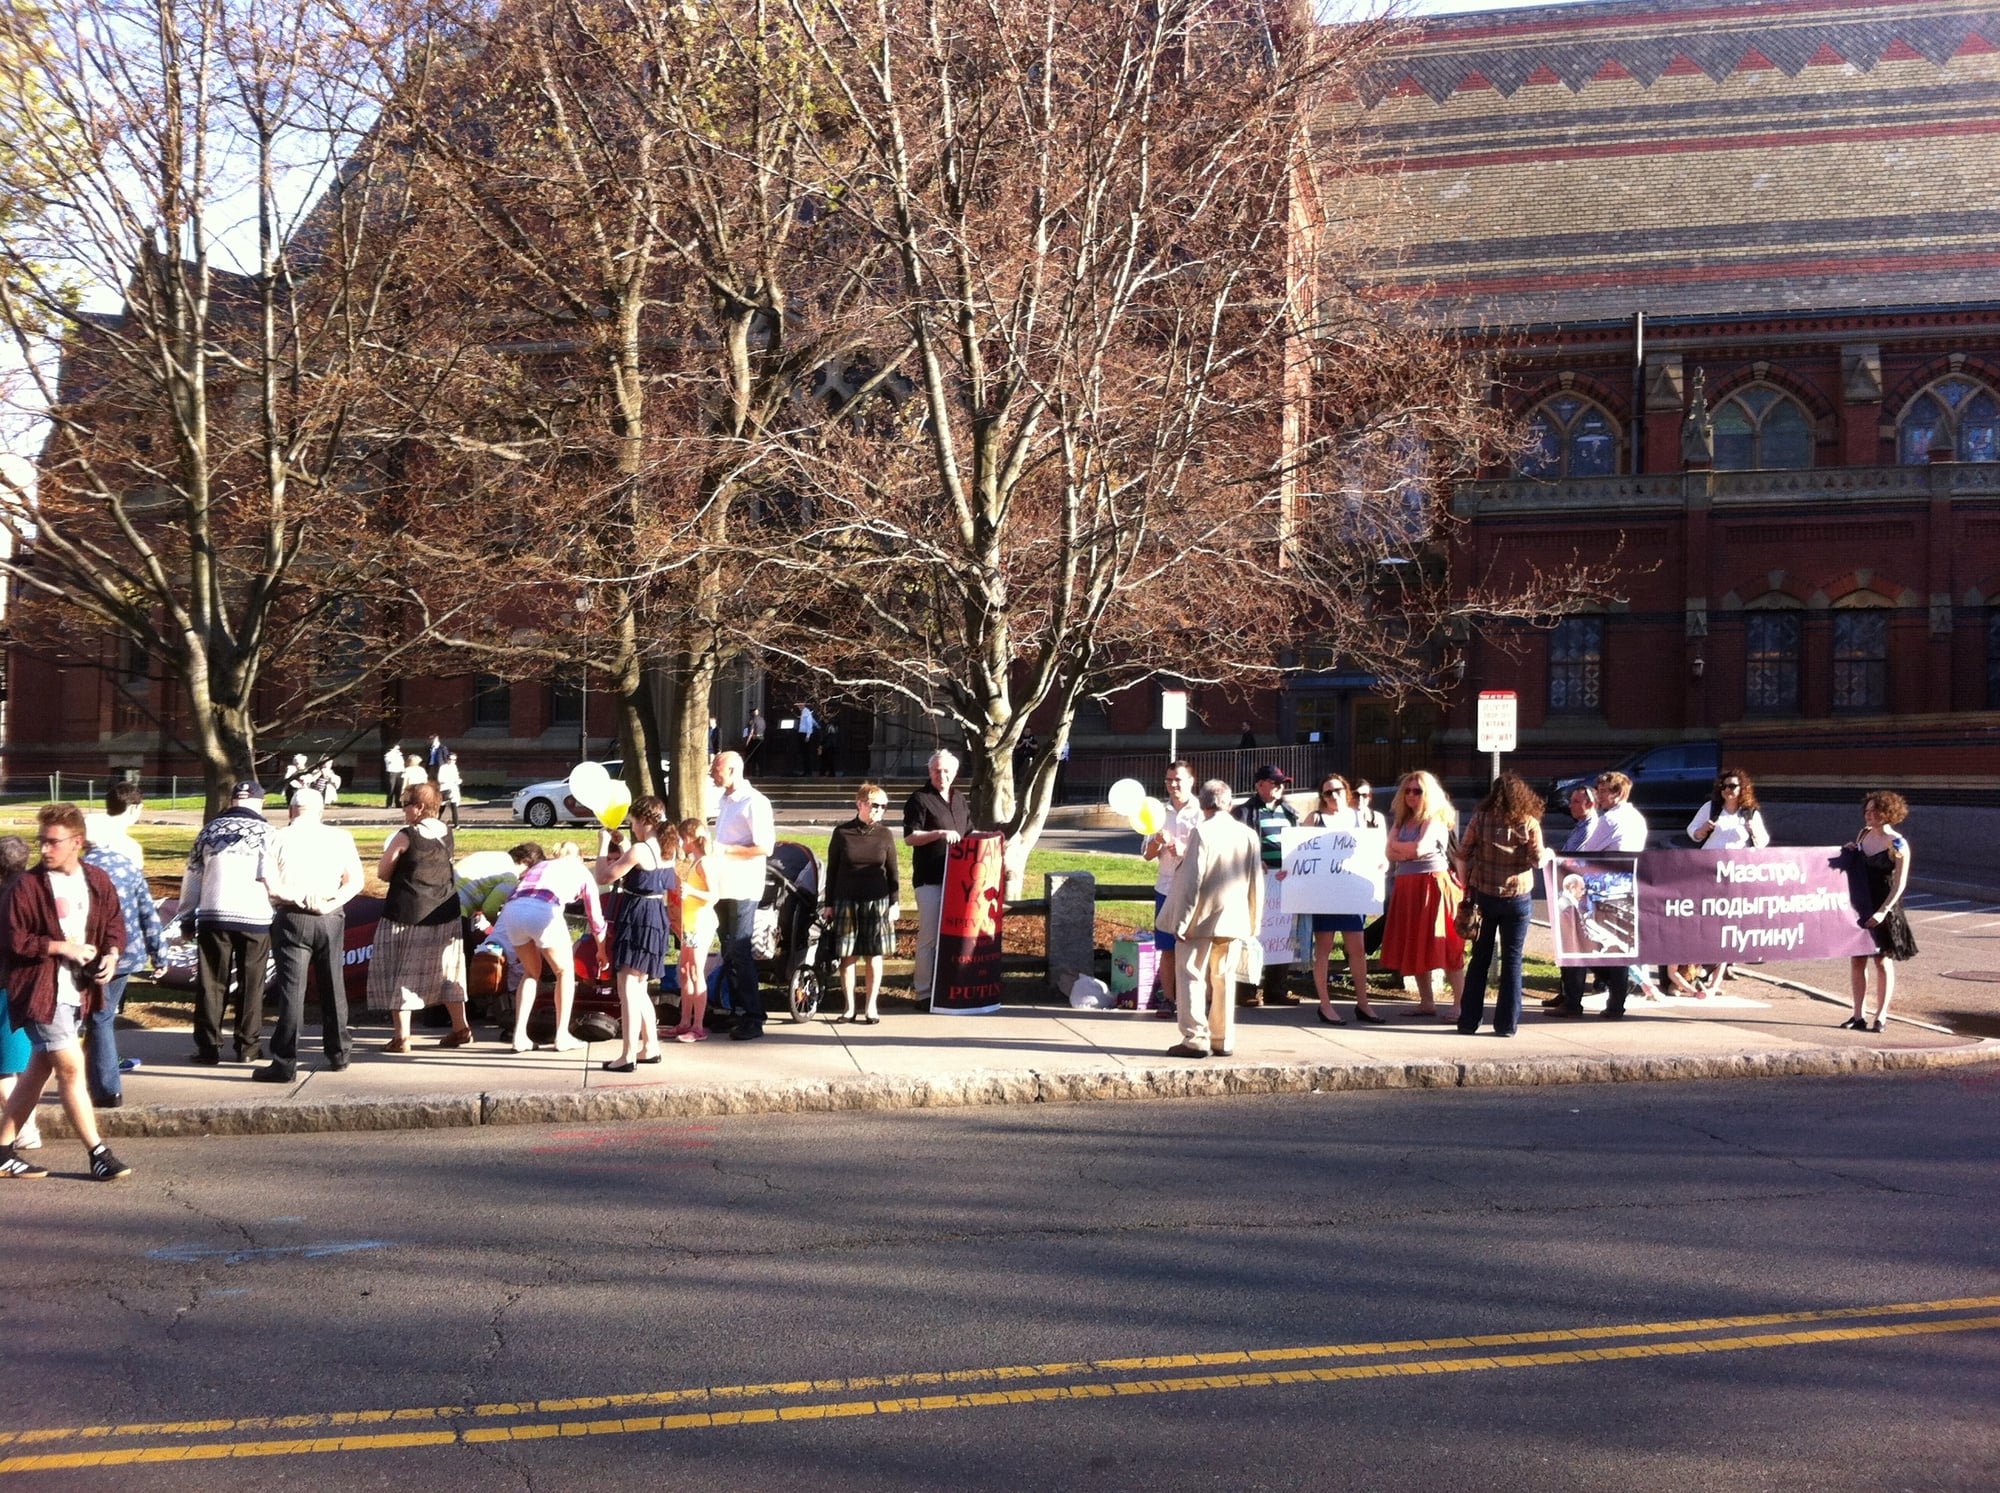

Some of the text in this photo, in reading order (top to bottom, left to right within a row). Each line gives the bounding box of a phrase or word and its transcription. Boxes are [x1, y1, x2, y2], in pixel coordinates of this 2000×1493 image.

[950, 839, 1000, 865] SHAM
[1292, 858, 1321, 876] NOT
[1716, 860, 1807, 887] Маэстро,
[1665, 898, 1694, 917] не
[1720, 922, 1805, 953] Путину!
